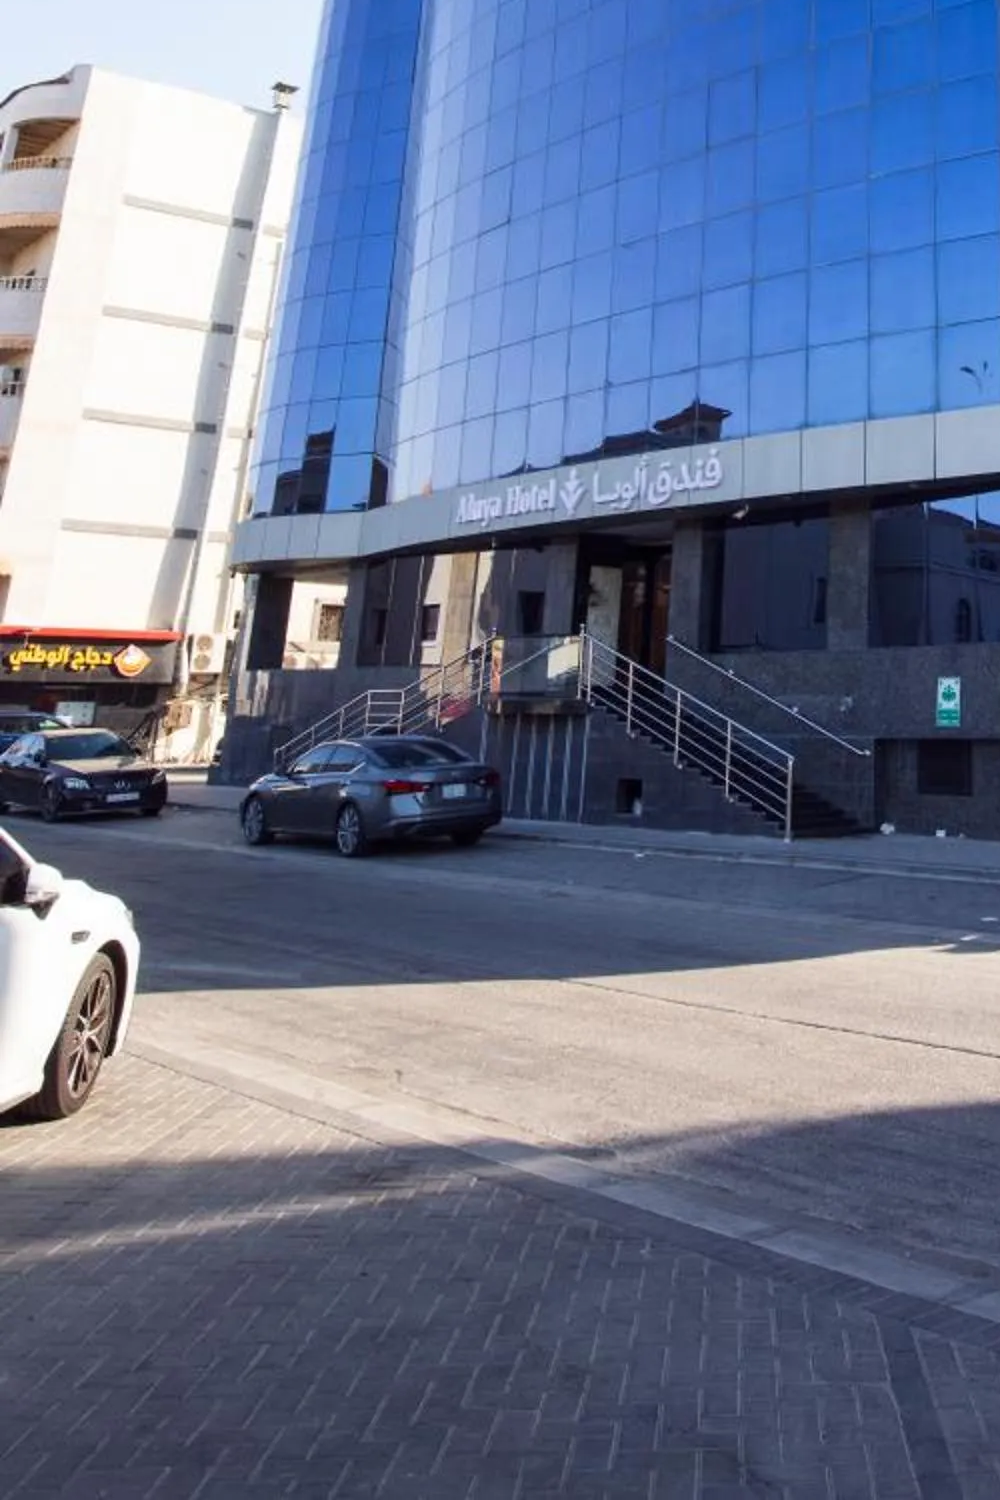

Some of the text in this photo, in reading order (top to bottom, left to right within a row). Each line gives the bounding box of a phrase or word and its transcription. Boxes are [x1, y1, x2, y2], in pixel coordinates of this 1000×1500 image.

[647, 448, 722, 506] فندق
[507, 479, 556, 515] Hotel
[70, 646, 113, 672] دجاج
